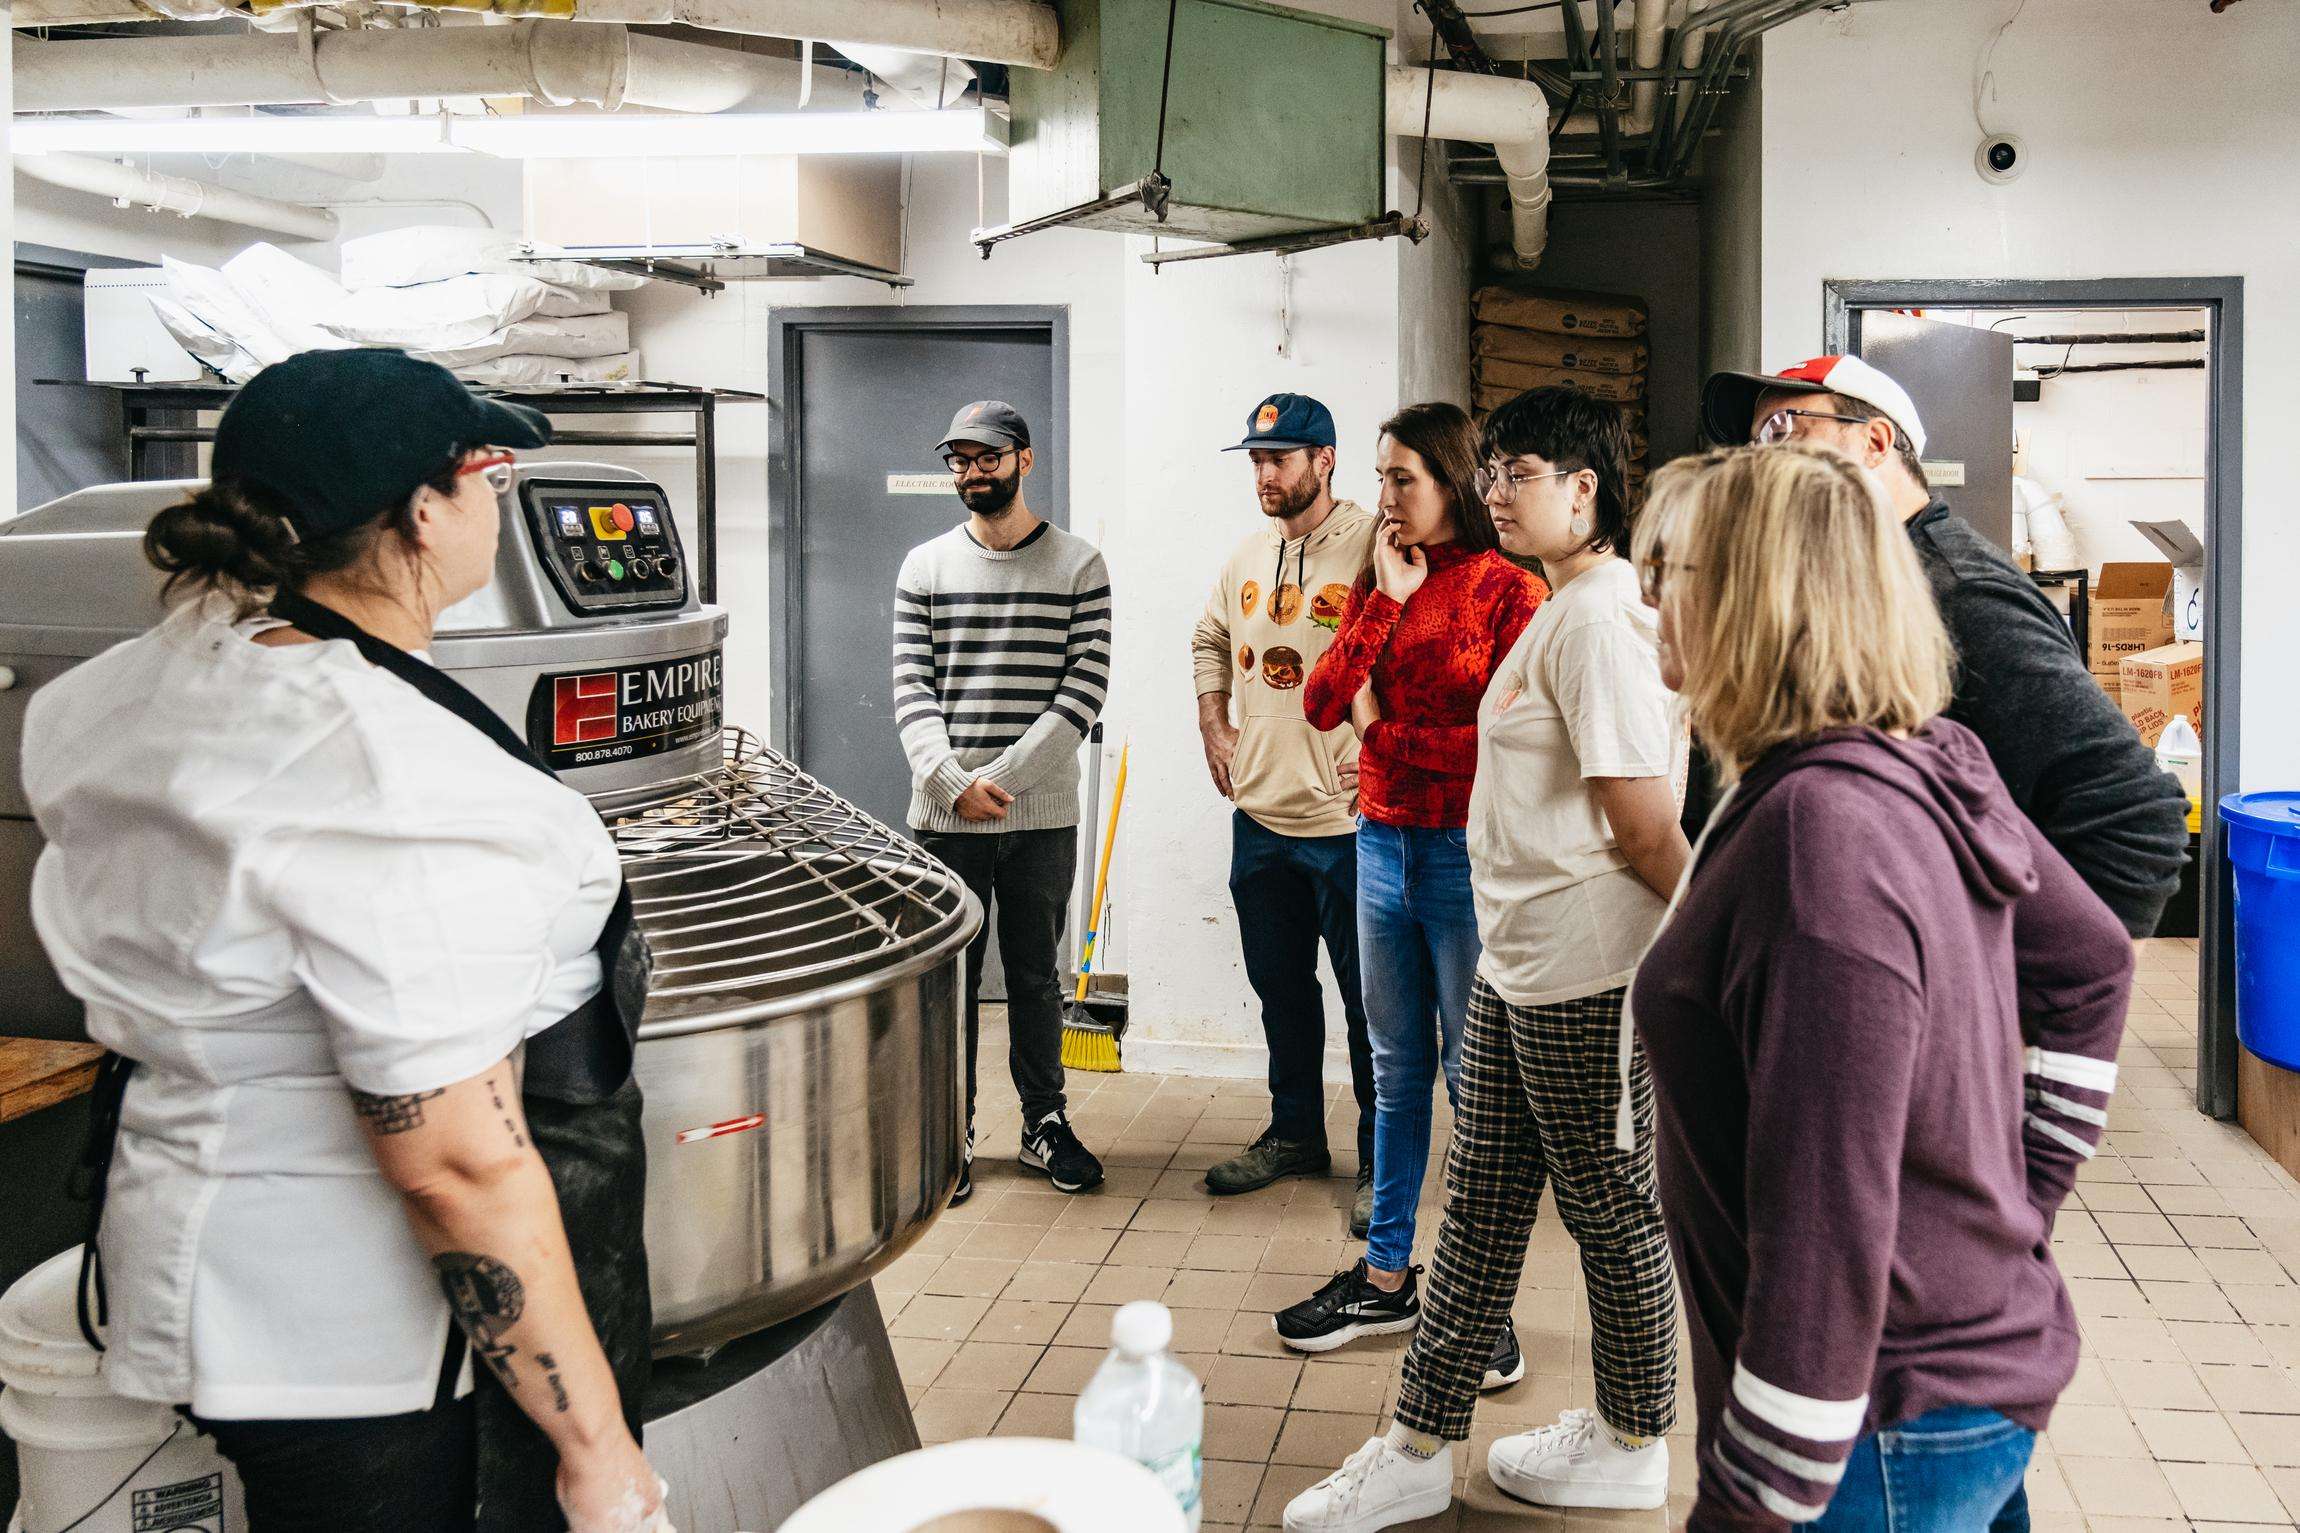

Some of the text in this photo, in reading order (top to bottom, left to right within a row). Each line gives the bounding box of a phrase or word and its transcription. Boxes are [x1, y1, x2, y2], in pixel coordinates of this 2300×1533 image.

[895, 479, 938, 488] ELECTRIC
[2101, 643, 2146, 652] LHRDS-16
[622, 655, 721, 706] EMPIRE
[622, 708, 675, 733] BAKERY
[575, 745, 633, 762] 800.878.4070
